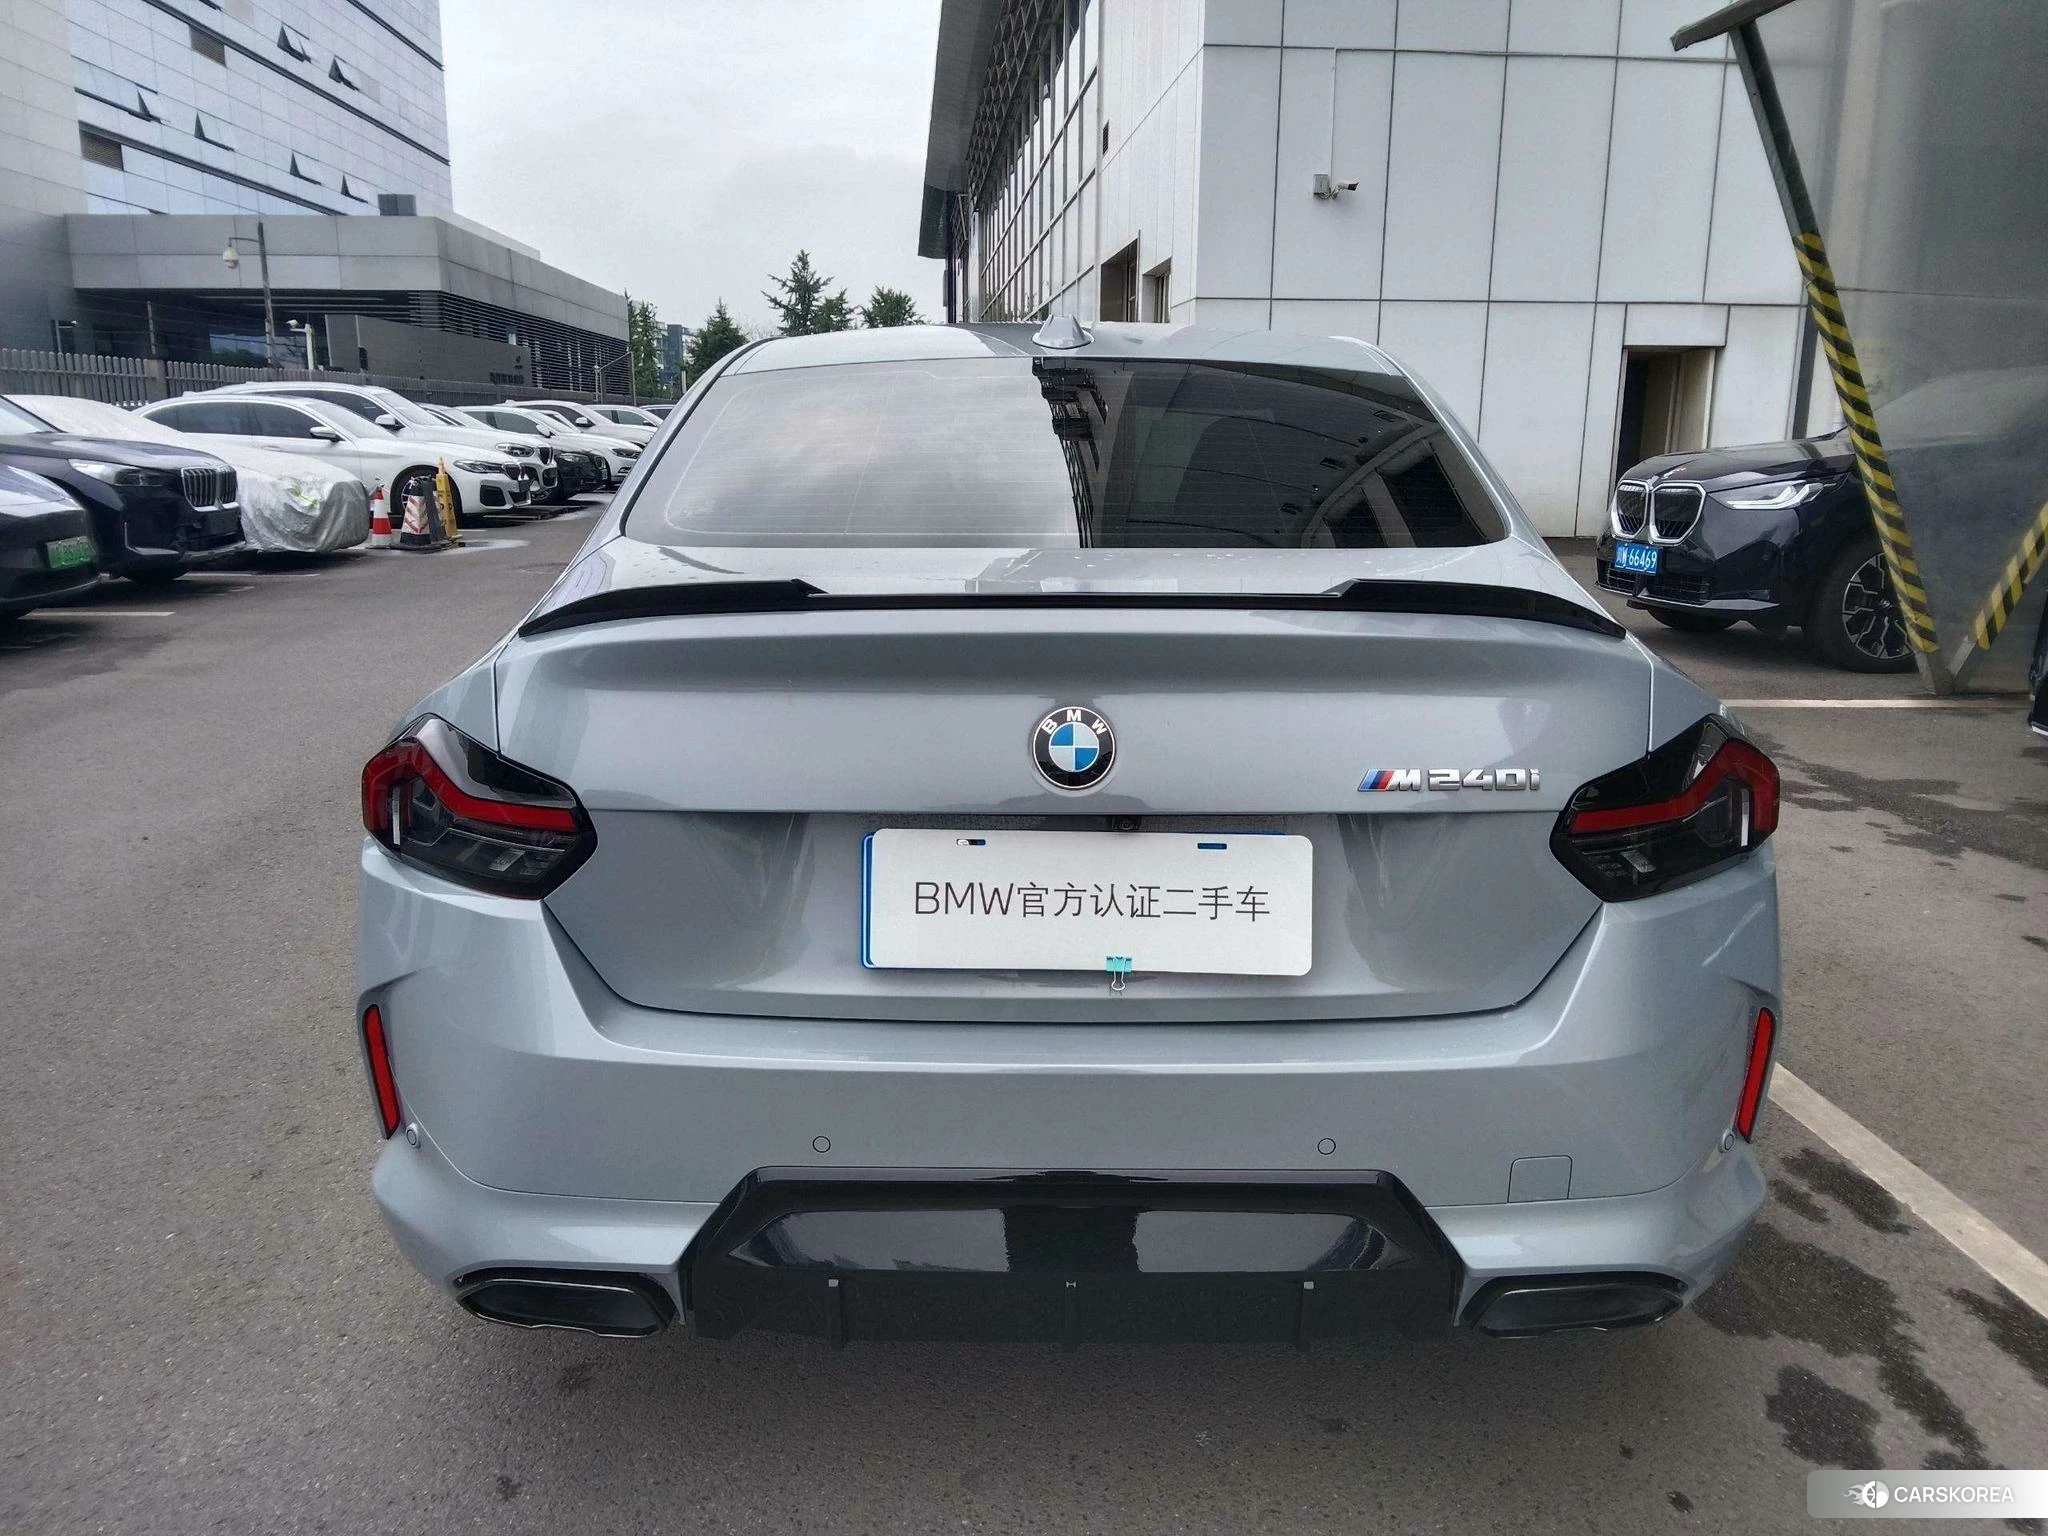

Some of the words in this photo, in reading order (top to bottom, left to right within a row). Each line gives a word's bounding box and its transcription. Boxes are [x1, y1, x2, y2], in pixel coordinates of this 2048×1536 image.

[1041, 710, 1107, 735] BMW
[914, 881, 1270, 922] BMW官方认证二手车
